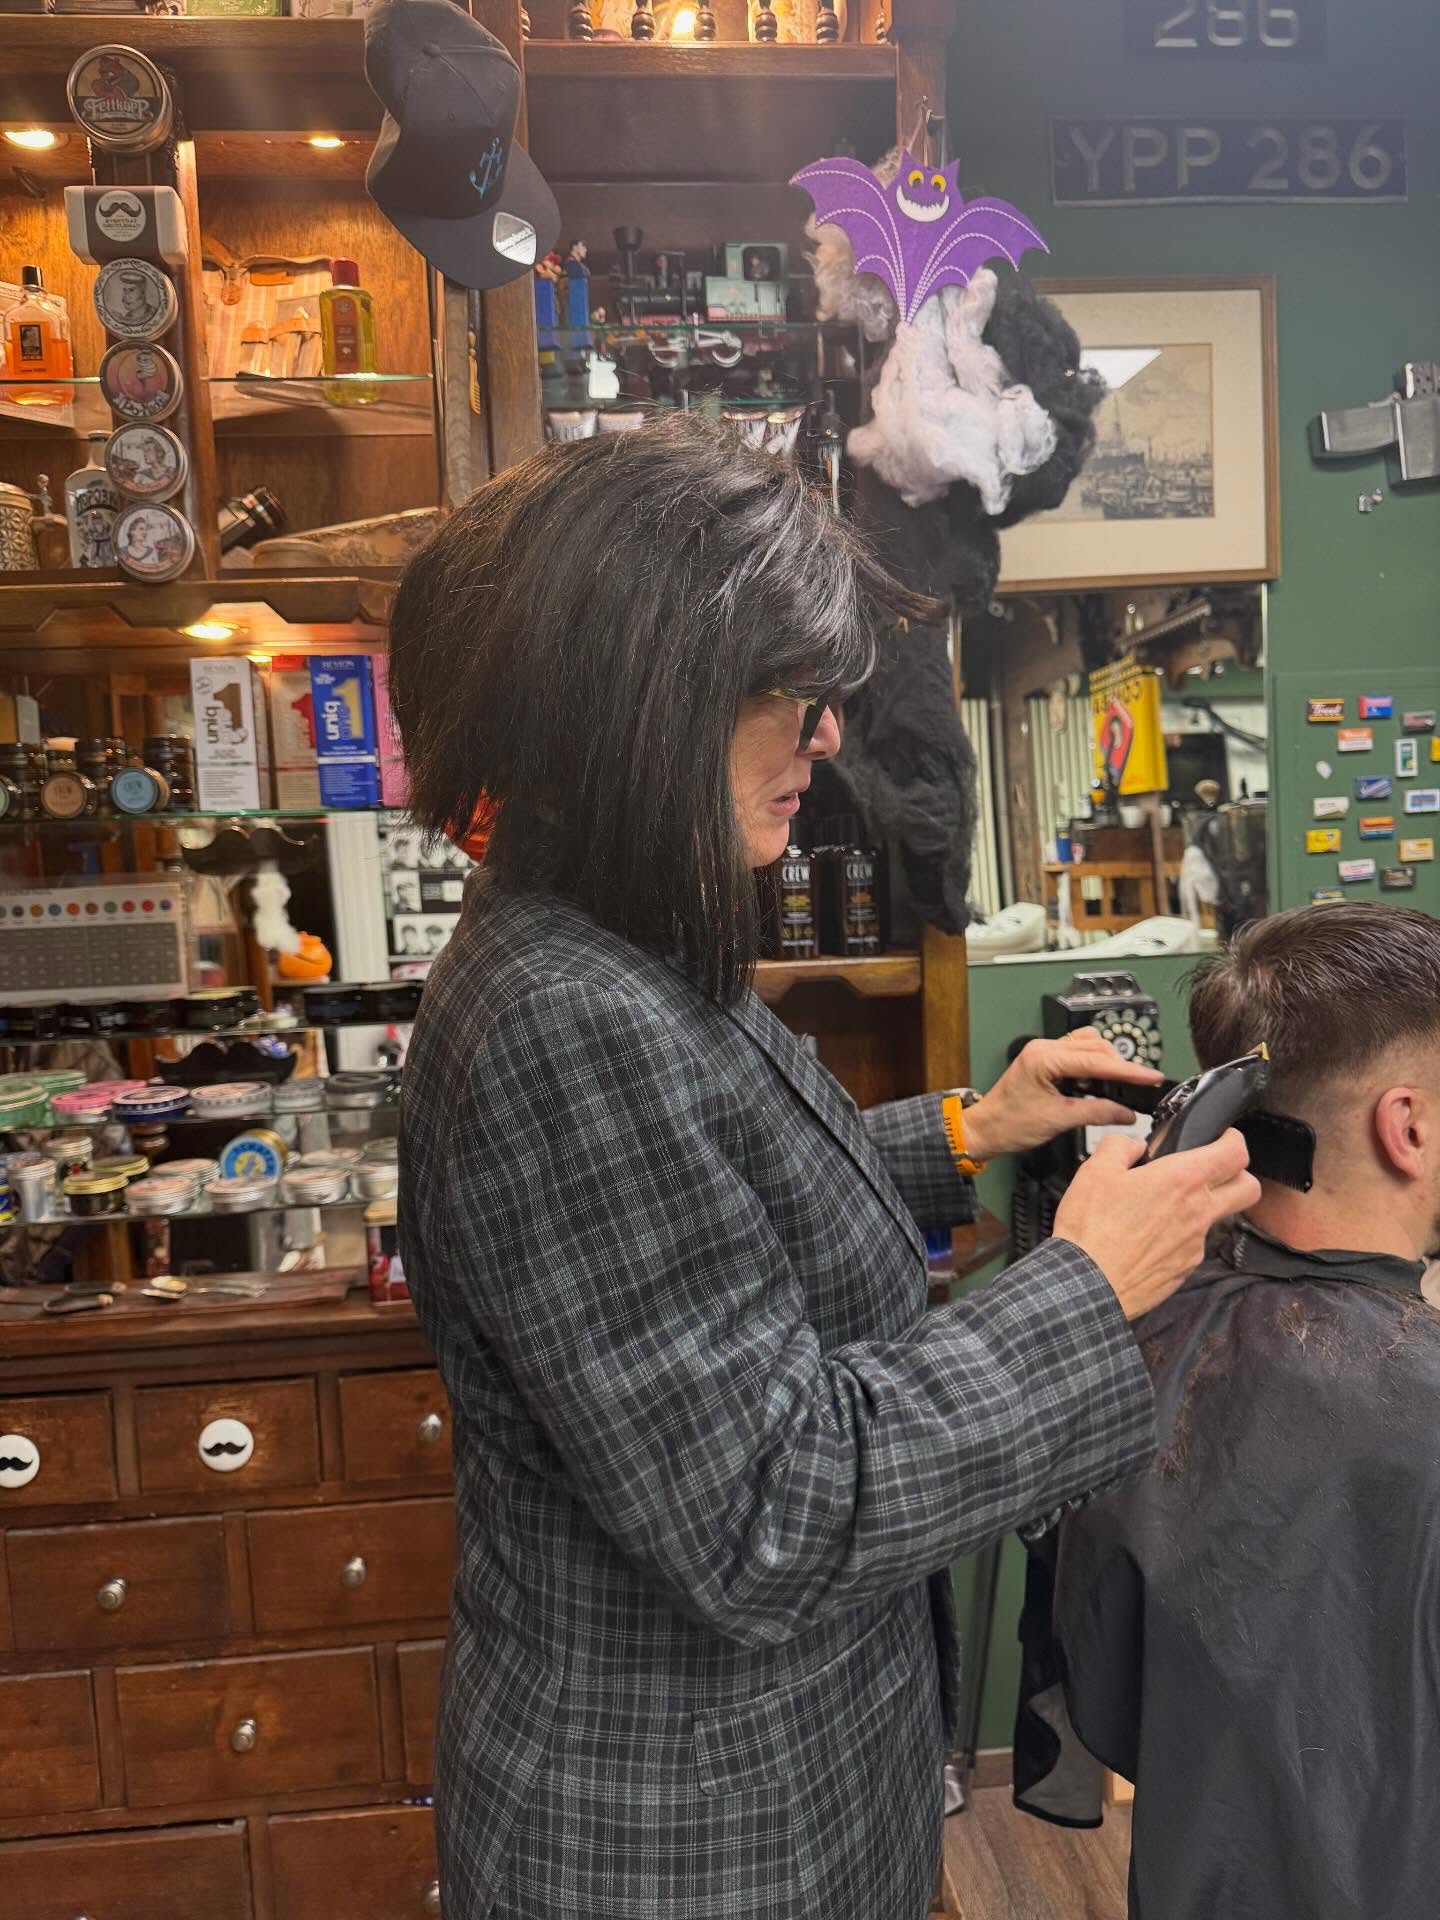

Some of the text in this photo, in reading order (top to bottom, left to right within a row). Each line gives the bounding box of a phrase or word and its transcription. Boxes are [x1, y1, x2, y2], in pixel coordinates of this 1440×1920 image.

[1071, 124, 1393, 191] YPP 286
[202, 706, 222, 744] uniq
[321, 701, 341, 740] uniq
[782, 865, 811, 882] CREW
[846, 863, 873, 880] CREW
